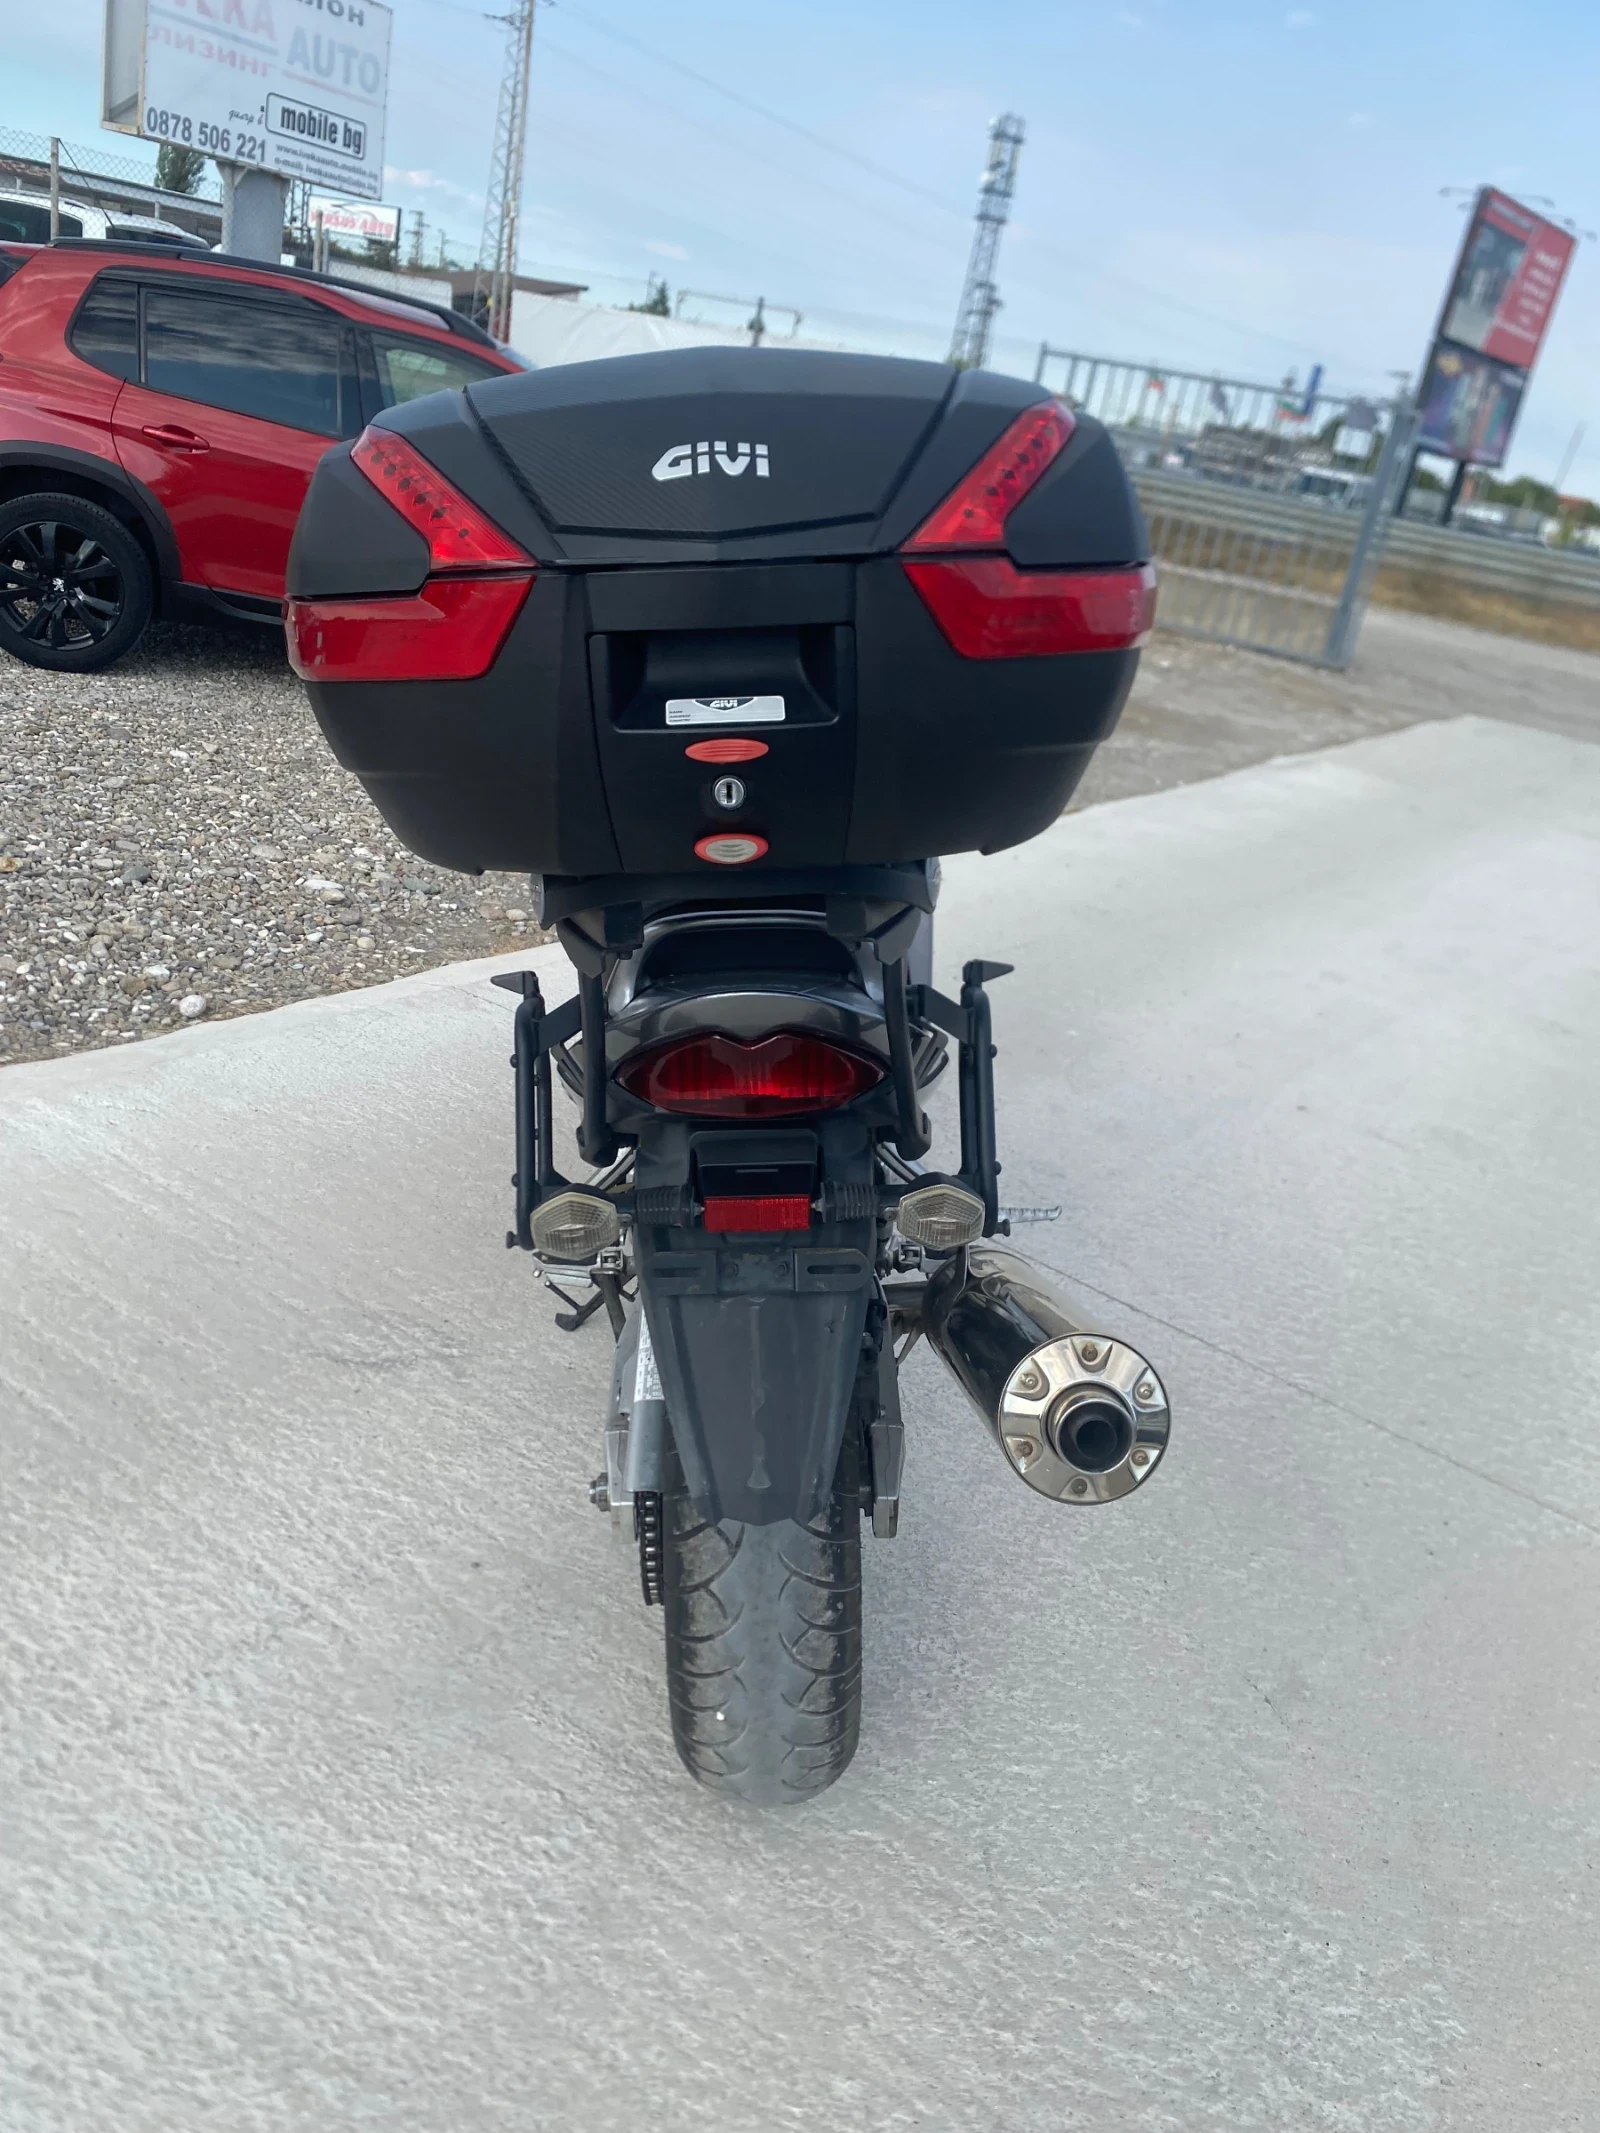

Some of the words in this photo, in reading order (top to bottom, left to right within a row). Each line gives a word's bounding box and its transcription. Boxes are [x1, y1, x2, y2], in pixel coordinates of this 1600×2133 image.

[148, 23, 279, 78] ЛИЗИНГ
[286, 25, 381, 93] AUTO
[146, 106, 192, 142] 0878
[198, 120, 231, 152] 506
[235, 132, 266, 162] 221
[280, 105, 338, 144] mobile
[342, 120, 362, 155] bg
